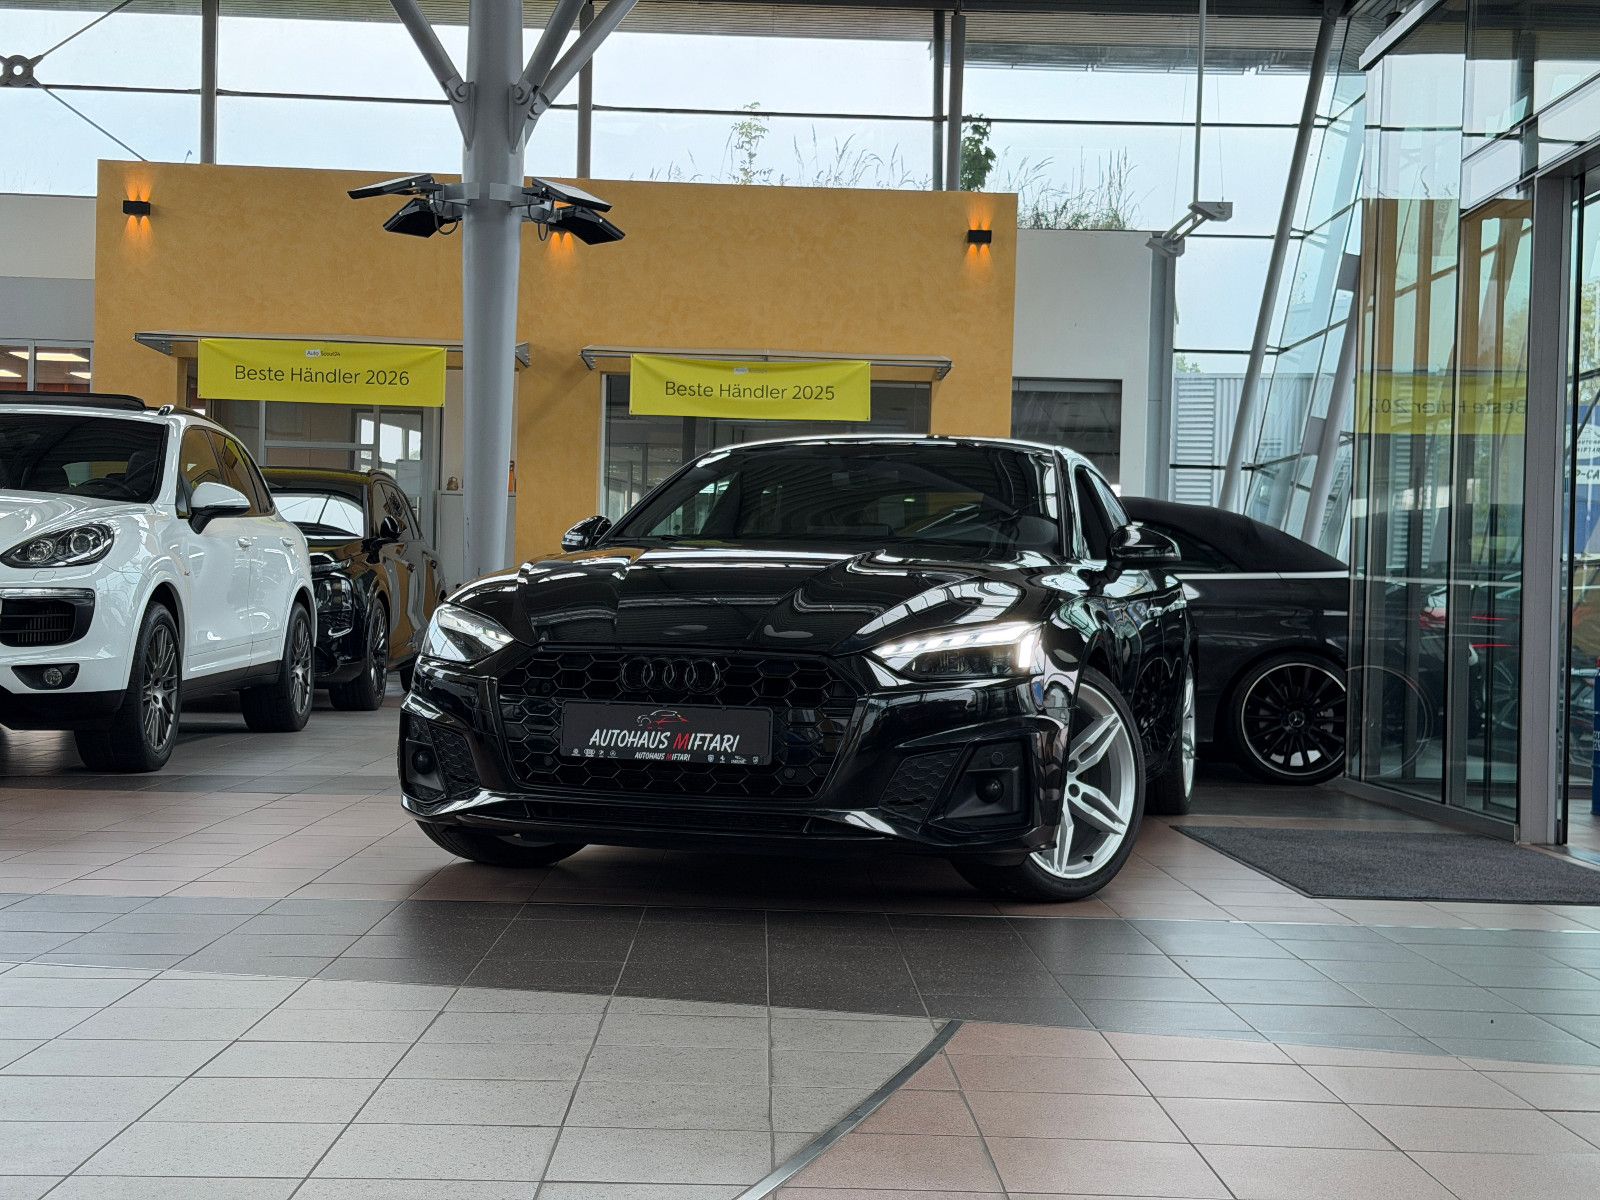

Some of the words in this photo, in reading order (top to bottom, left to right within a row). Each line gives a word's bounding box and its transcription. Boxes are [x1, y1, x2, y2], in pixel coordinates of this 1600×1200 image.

[235, 365, 285, 382] Beste
[291, 367, 361, 384] Händler
[365, 369, 410, 386] 2026
[665, 380, 714, 397] Beste
[719, 383, 788, 400] Händler
[792, 385, 835, 401] 2025
[588, 728, 671, 749] AUTOHAUS
[673, 732, 741, 753] MIFTARI
[634, 751, 666, 760] AUTOHAUS
[666, 752, 691, 762] MIFTARI
